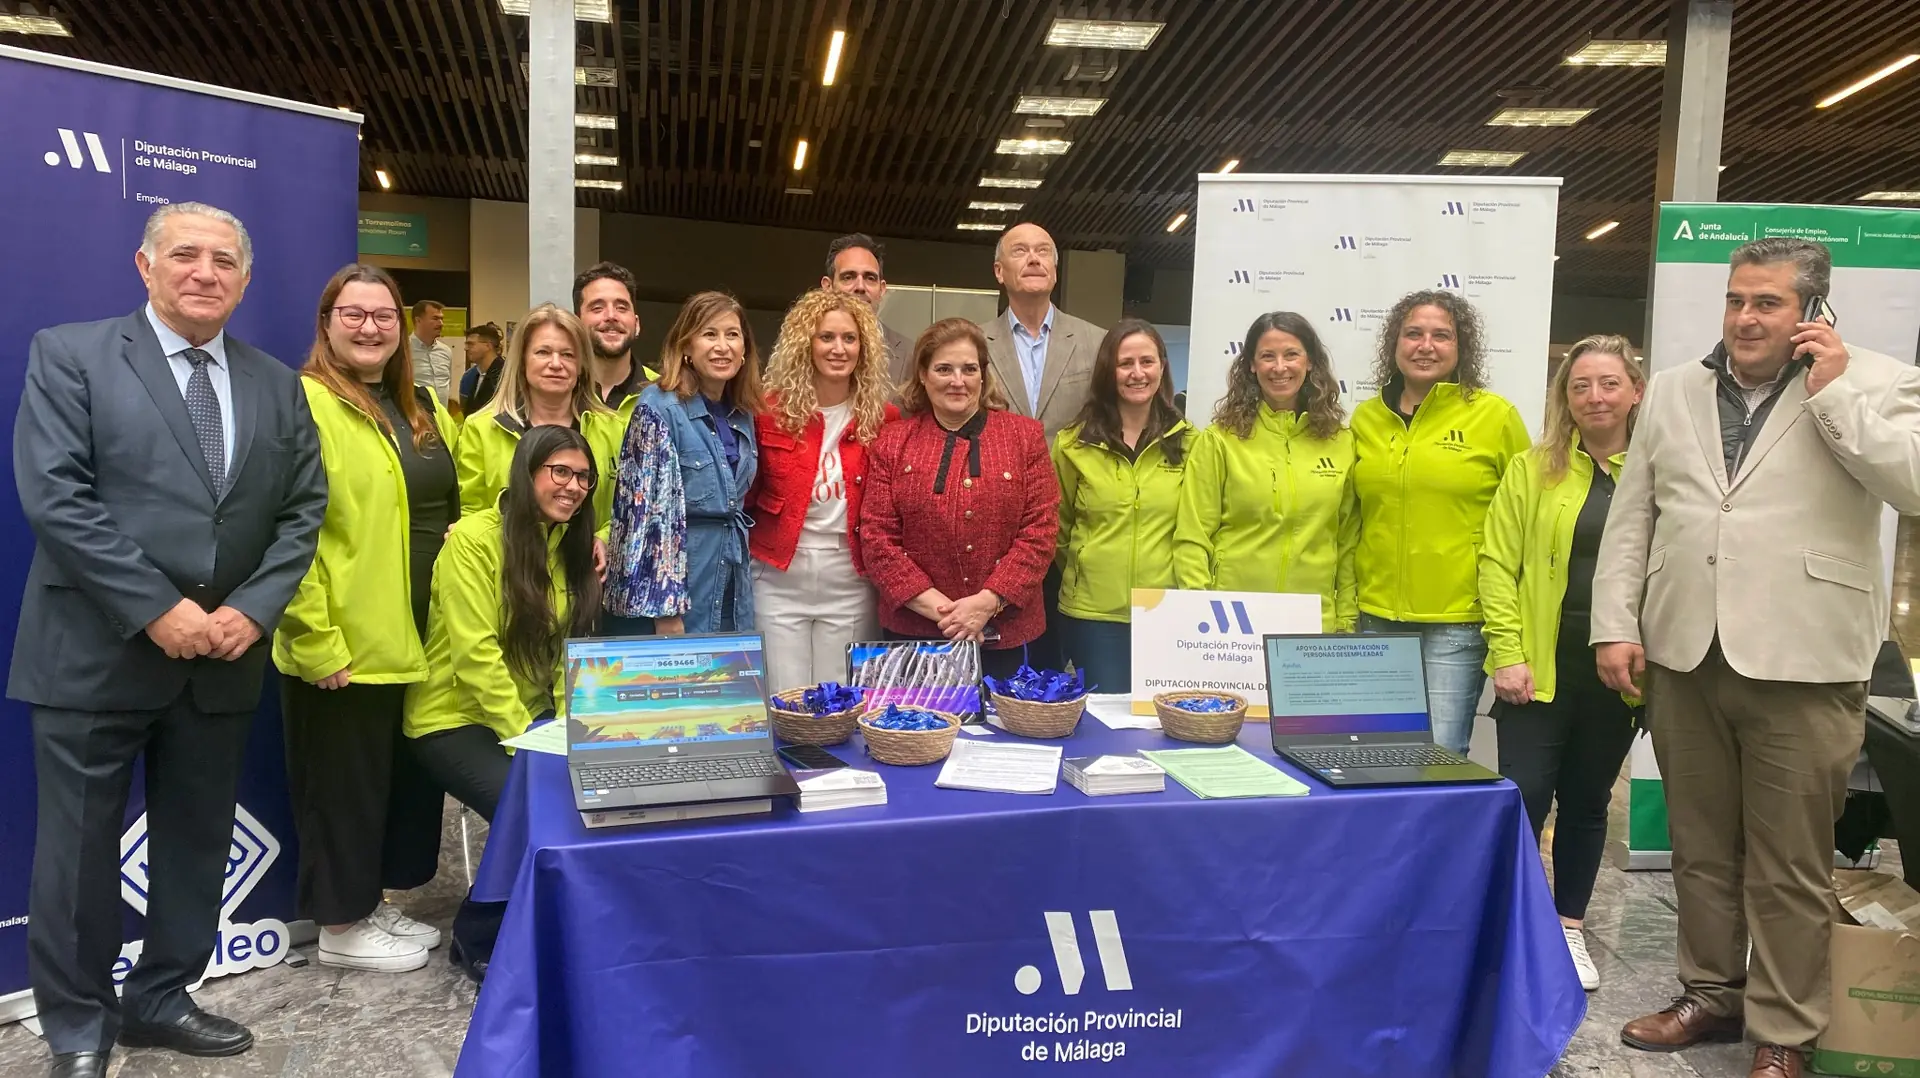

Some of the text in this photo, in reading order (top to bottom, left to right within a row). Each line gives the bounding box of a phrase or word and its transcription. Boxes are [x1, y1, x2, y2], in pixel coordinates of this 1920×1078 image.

[134, 140, 257, 169] Diputación Provincial
[135, 155, 197, 175] de Málaga
[136, 192, 170, 205] Empleo
[1699, 222, 1722, 231] Junta
[1765, 227, 1796, 235] Consejería
[1804, 228, 1829, 236] Empleo,
[1698, 232, 1749, 241] de Andalucía
[1176, 639, 1229, 650] Diputación
[674, 659, 695, 667] 9466
[1202, 652, 1253, 664] de Málaga
[1145, 679, 1268, 691] DIPUTACIÓN PROVINCIAL D
[966, 1007, 1182, 1037] Diputación Provincial
[1021, 1038, 1126, 1062] de Málaga
